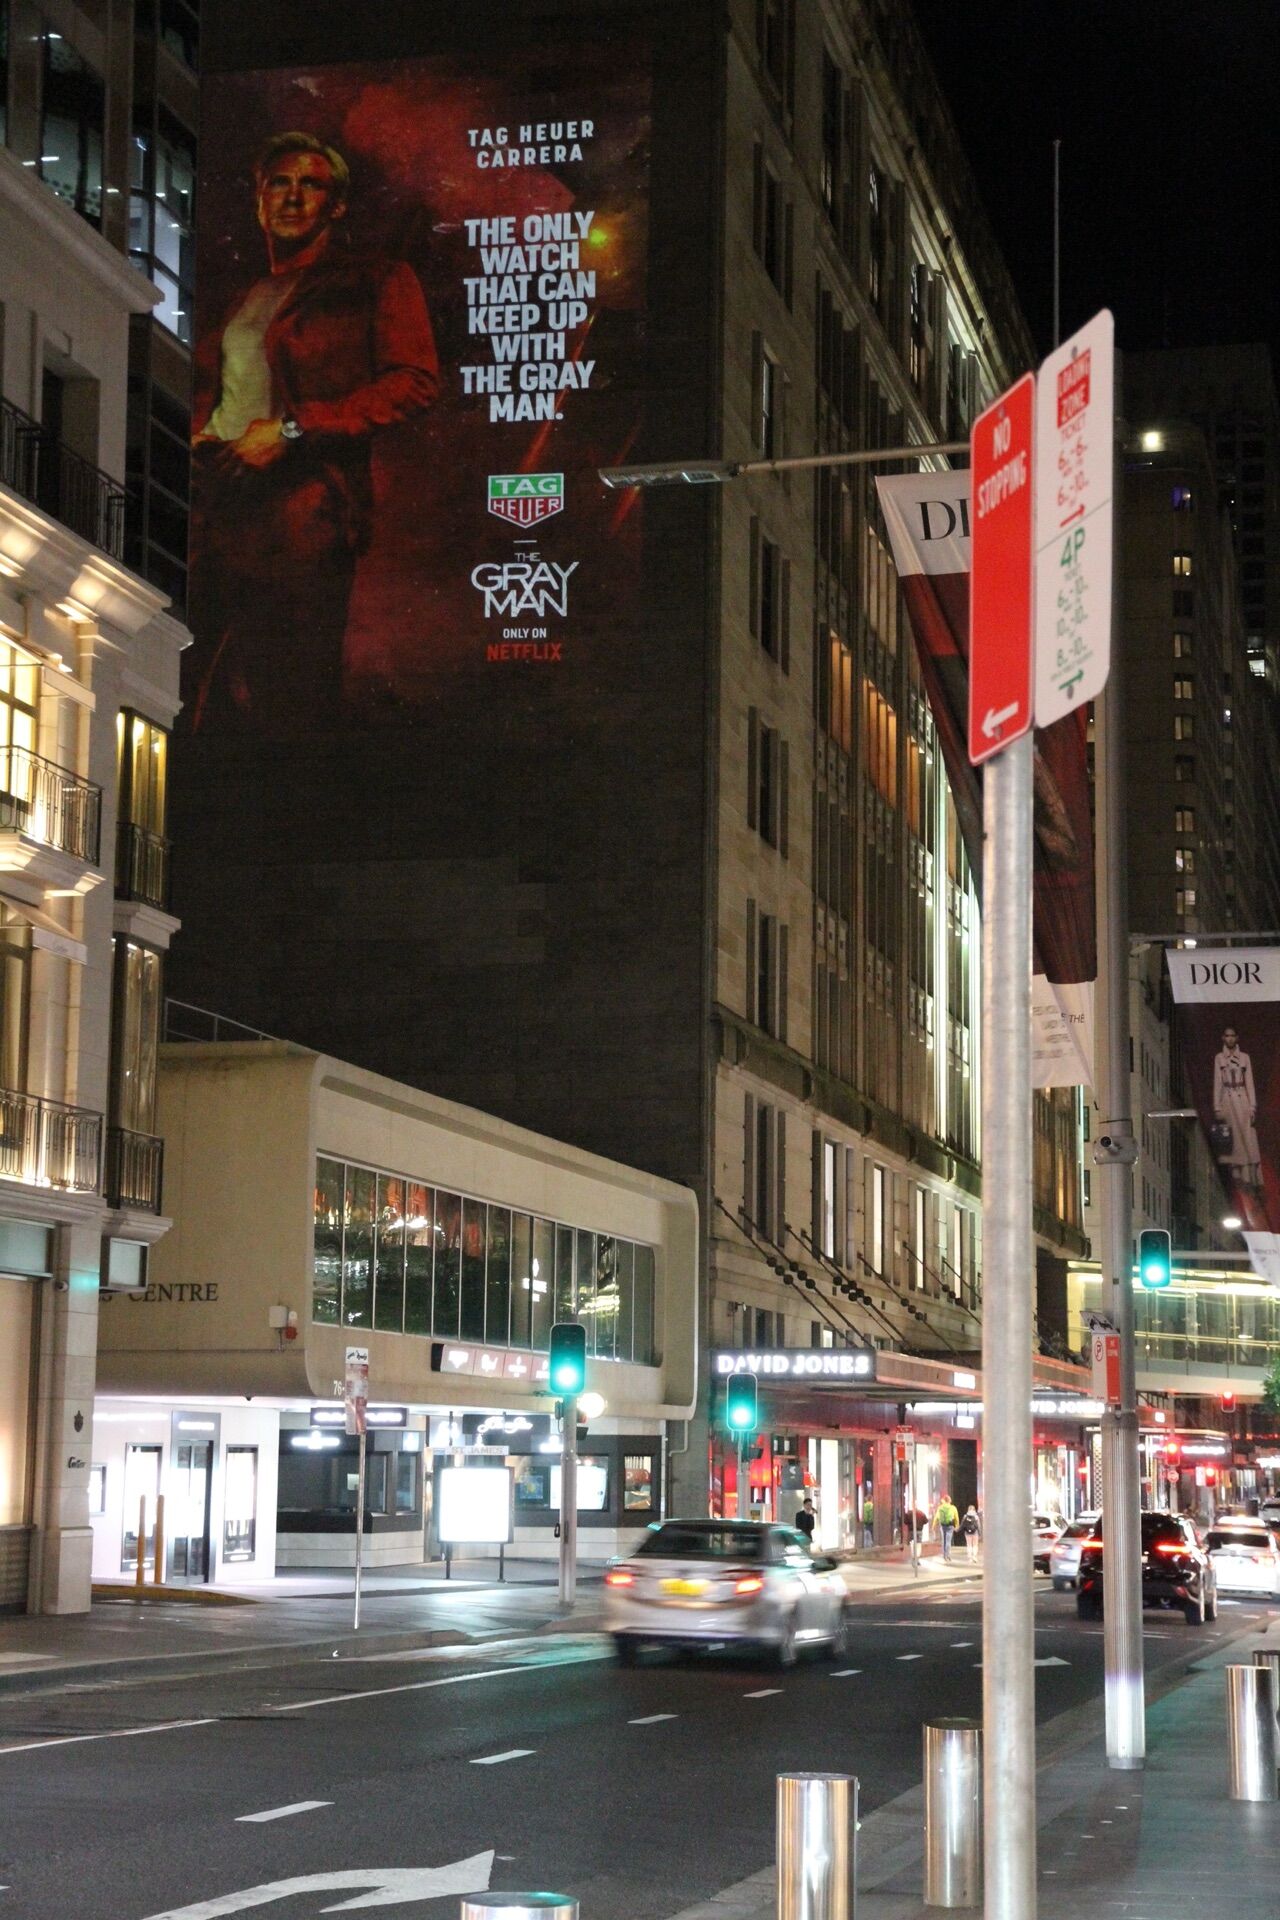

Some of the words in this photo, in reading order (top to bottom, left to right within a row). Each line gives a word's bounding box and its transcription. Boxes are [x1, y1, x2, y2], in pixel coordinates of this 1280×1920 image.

[468, 127, 508, 147] TAG
[520, 120, 594, 143] HEUER
[477, 144, 583, 169] CARRERA
[464, 217, 516, 246] THE
[523, 211, 595, 243] ONLY
[480, 242, 580, 275] WATCH
[463, 274, 532, 305] THAT
[538, 270, 596, 300] CAN
[468, 303, 540, 334] KEEP
[548, 301, 588, 330] UP
[491, 332, 565, 362] WITH
[460, 364, 512, 394] THE
[519, 360, 596, 391] GRAY
[490, 392, 564, 422] MAN.
[993, 416, 1012, 460] NO
[495, 477, 557, 495] TAG
[977, 450, 1027, 519] STOPPING
[493, 498, 560, 524] HEUER
[915, 498, 970, 541] DI
[514, 552, 541, 562] THE
[1060, 527, 1086, 568] 4P
[471, 562, 580, 591] GRAY
[484, 589, 568, 618] MAN
[503, 628, 530, 639] ONLY
[532, 627, 547, 639] ON
[486, 643, 562, 662] NETFLIX
[1188, 962, 1264, 985] DIOR
[1069, 1014, 1085, 1024] THE
[717, 1354, 790, 1373] DAVID
[792, 1354, 870, 1374] JONES
